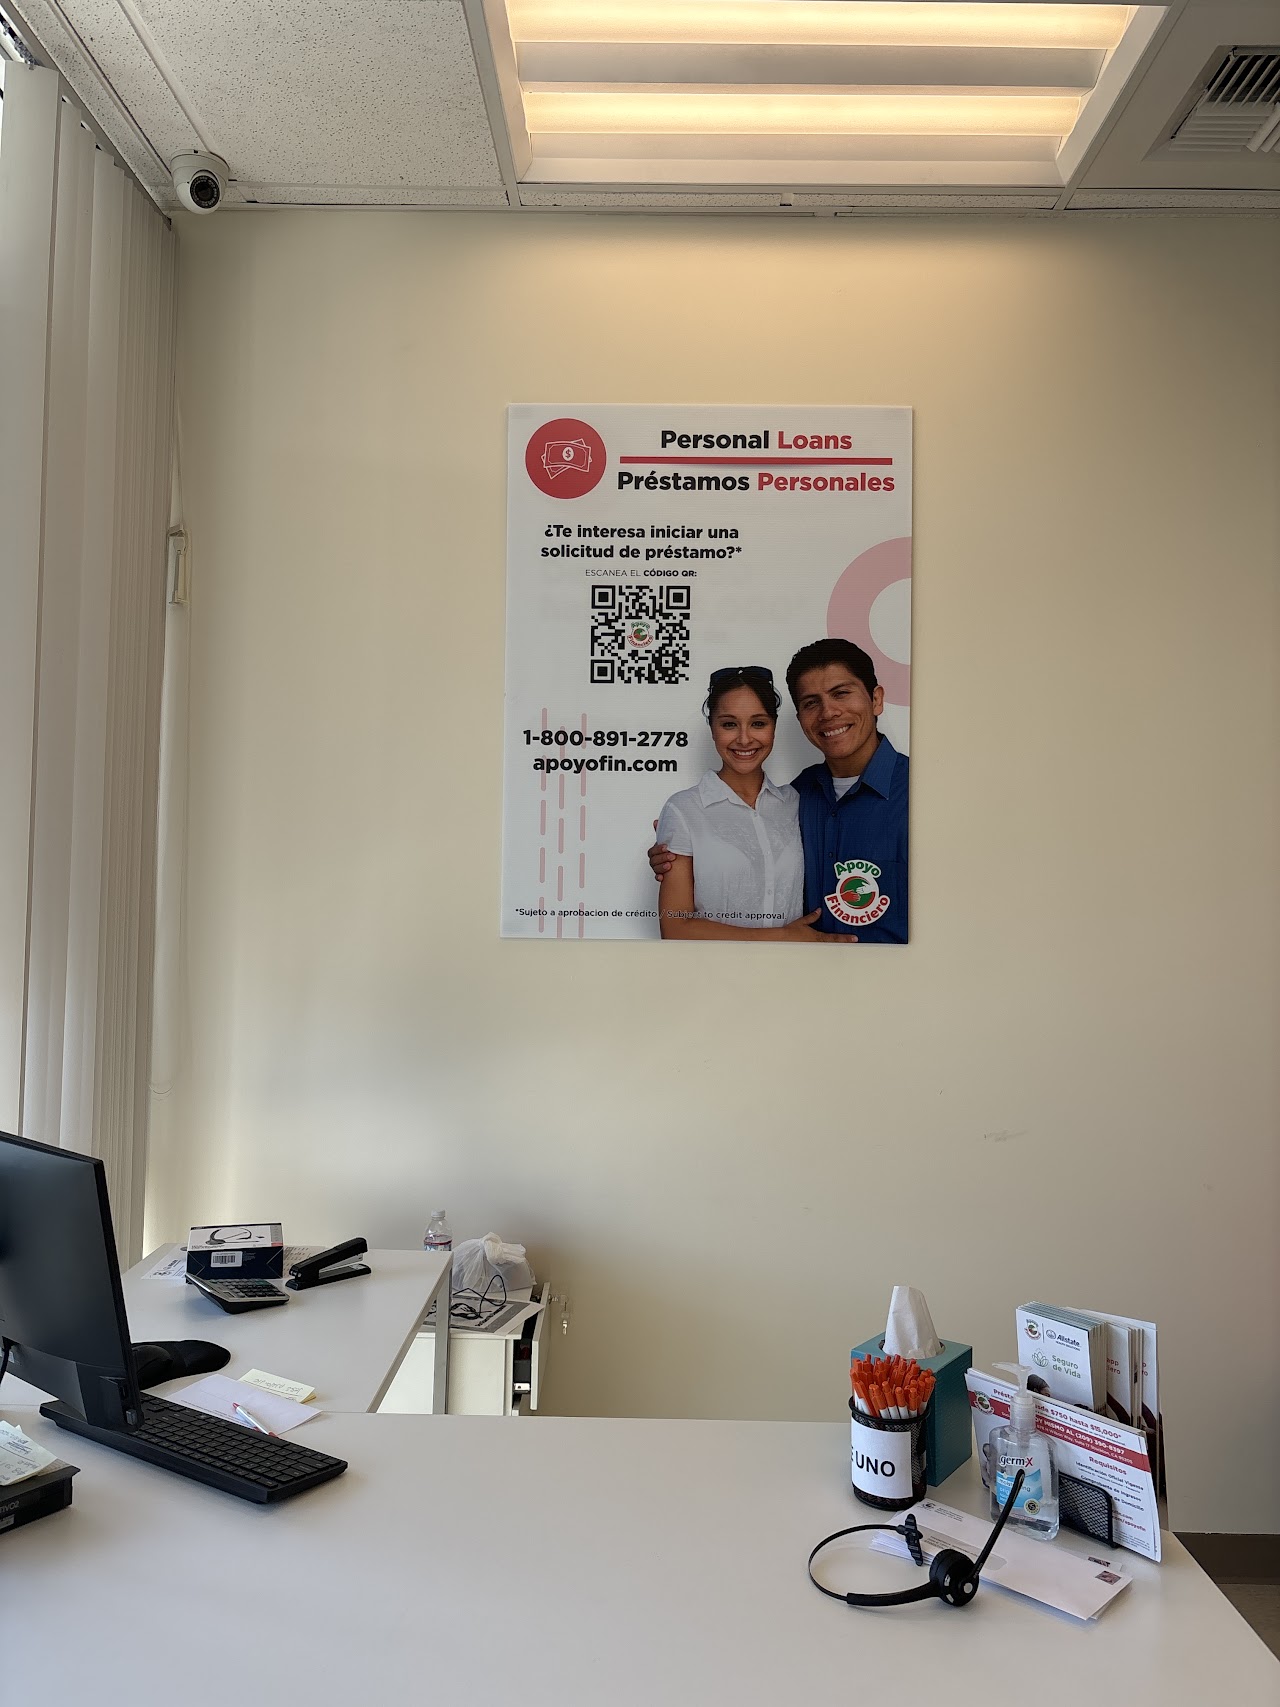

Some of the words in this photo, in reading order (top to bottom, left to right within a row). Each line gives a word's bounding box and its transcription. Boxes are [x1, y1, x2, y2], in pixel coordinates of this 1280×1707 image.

[661, 430, 770, 449] Personal
[778, 431, 853, 450] Loans
[617, 470, 750, 491] Préstamos
[757, 472, 895, 492] Personales
[544, 524, 573, 538] ¿Te
[577, 525, 646, 539] interesa
[650, 525, 703, 539] iniciar
[707, 528, 739, 539] una
[540, 545, 614, 558] solicitud
[619, 545, 641, 559] de
[585, 569, 628, 577] ESCANEA
[630, 569, 641, 577] EL
[643, 567, 679, 577] CÓDIGO
[681, 569, 698, 578] QR:
[523, 729, 689, 747] 1-800-891-2778
[533, 755, 678, 774] apoyofin.com
[835, 861, 880, 876] Apoyo
[558, 908, 609, 918] aprobacion
[611, 909, 623, 917] de
[625, 909, 658, 918] crédito
[704, 911, 713, 919] to
[716, 911, 743, 919] credit
[745, 911, 787, 921] approval.
[826, 895, 889, 924] Financiero
[1052, 1354, 1079, 1370] Seguro
[1052, 1364, 1063, 1373] de
[1065, 1367, 1081, 1379] Vida
[1050, 1410, 1068, 1420] $750
[1069, 1415, 1089, 1428] hasta
[1065, 1429, 1075, 1437] AL
[856, 1450, 896, 1477] UNO
[1088, 1456, 1128, 1476] Requisitos
